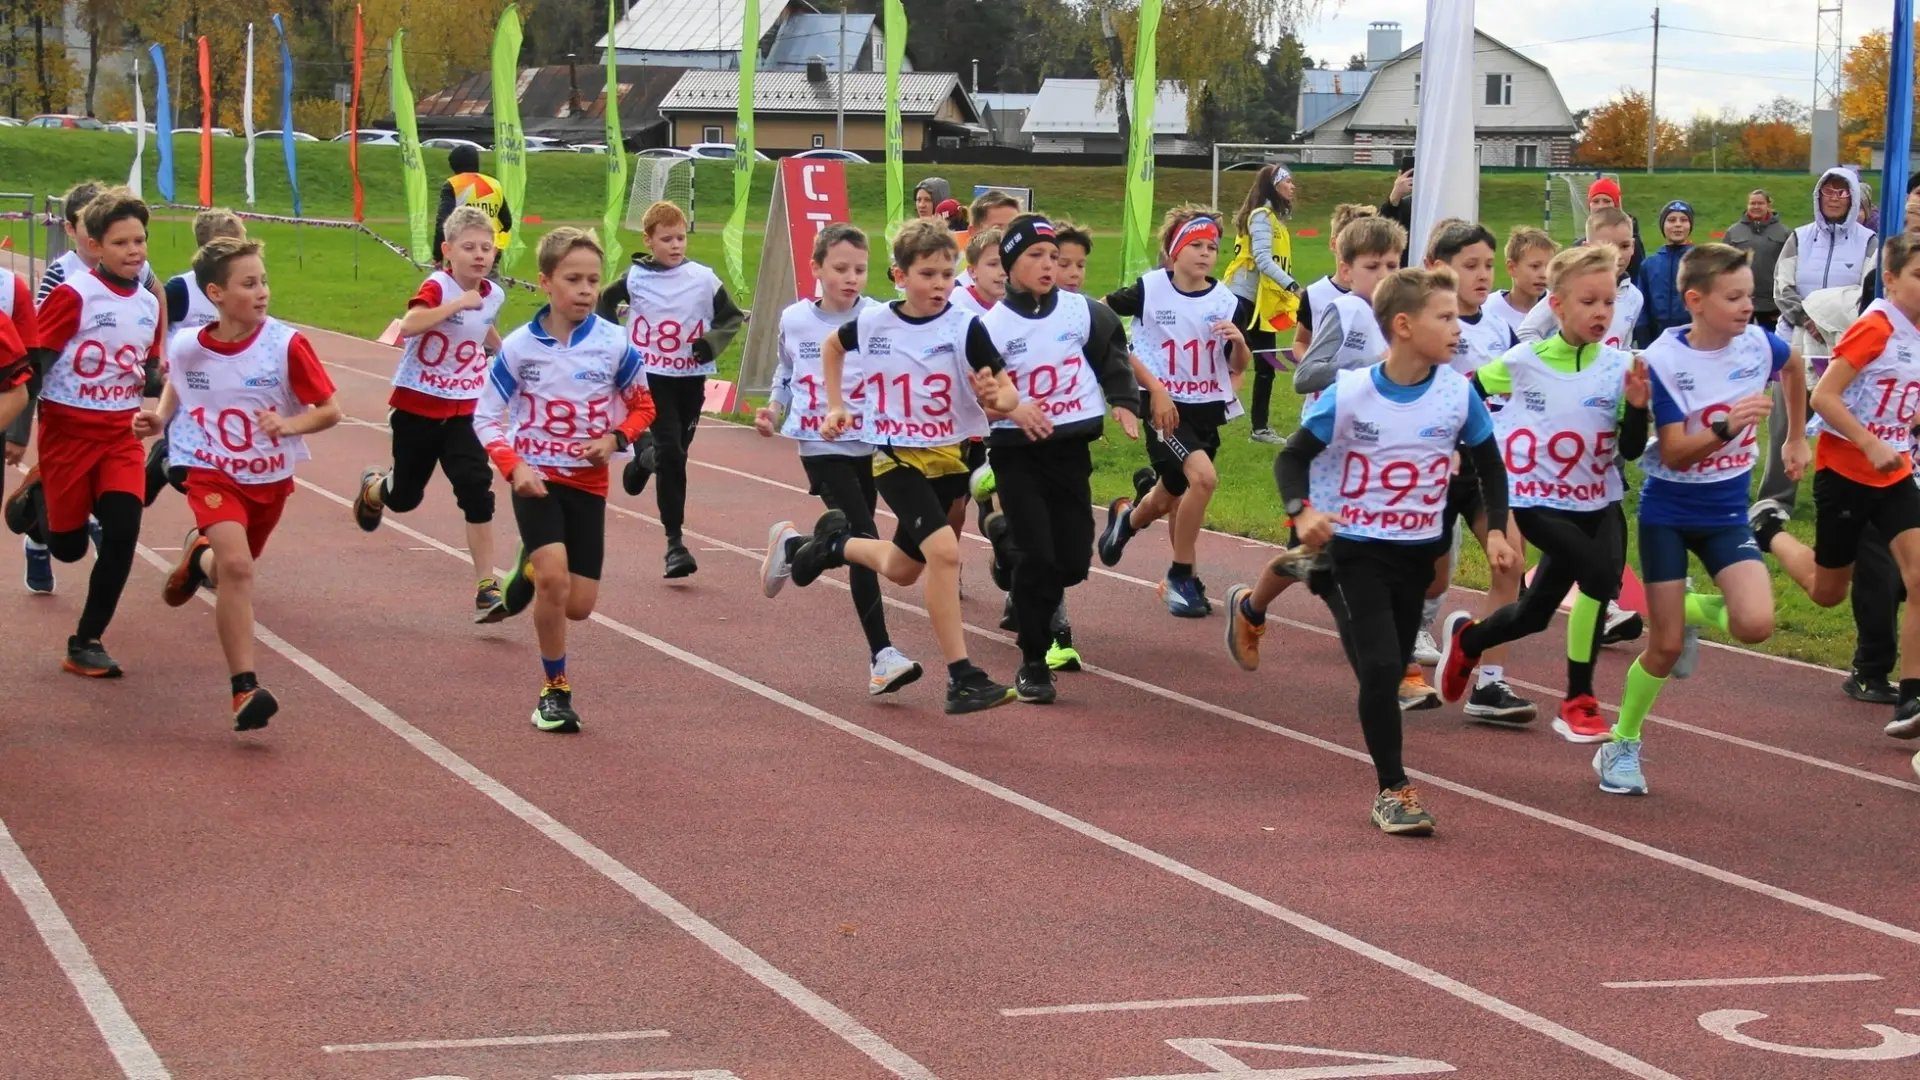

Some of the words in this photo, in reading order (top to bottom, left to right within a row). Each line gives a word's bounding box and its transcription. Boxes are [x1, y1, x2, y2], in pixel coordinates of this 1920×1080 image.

[1161, 339, 1216, 377] 111
[419, 370, 484, 391] МУРОМ
[798, 375, 865, 411] 12
[867, 372, 953, 418] 113
[874, 418, 954, 438] МУРОМ
[513, 435, 586, 459] МУРО
[1505, 428, 1618, 480] 095
[194, 448, 285, 474] МУРОМ
[1340, 450, 1449, 506] 093
[1515, 481, 1606, 501] МУРОМ
[1341, 504, 1438, 530] МУРОМ
